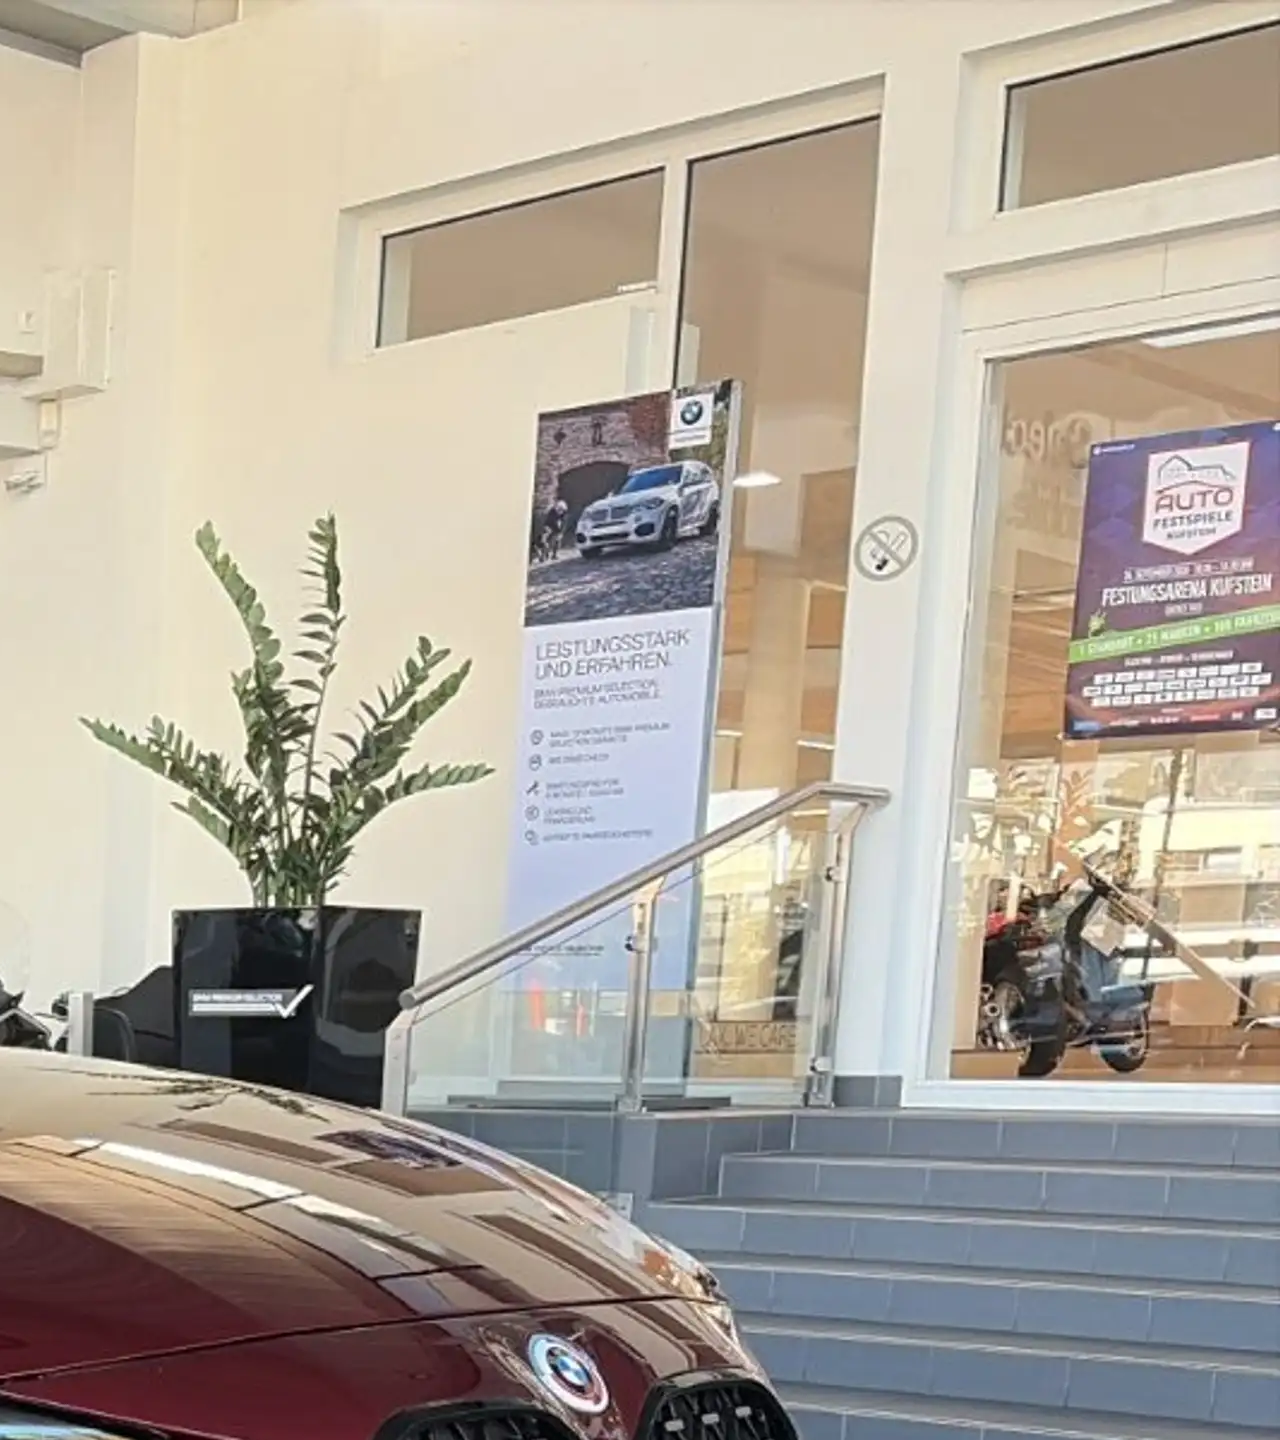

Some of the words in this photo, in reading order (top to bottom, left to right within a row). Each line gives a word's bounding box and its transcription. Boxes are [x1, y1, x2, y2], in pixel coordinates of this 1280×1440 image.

[1155, 488, 1234, 513] AUTO
[1153, 511, 1233, 530] FESTSPIELE
[1102, 579, 1207, 607] FESTUNGSARENA
[1210, 574, 1272, 597] KUFSTEIN
[536, 629, 691, 661] LEISTUNGSSTARK
[535, 661, 572, 680] UND
[575, 652, 672, 676] ERFAHREN.
